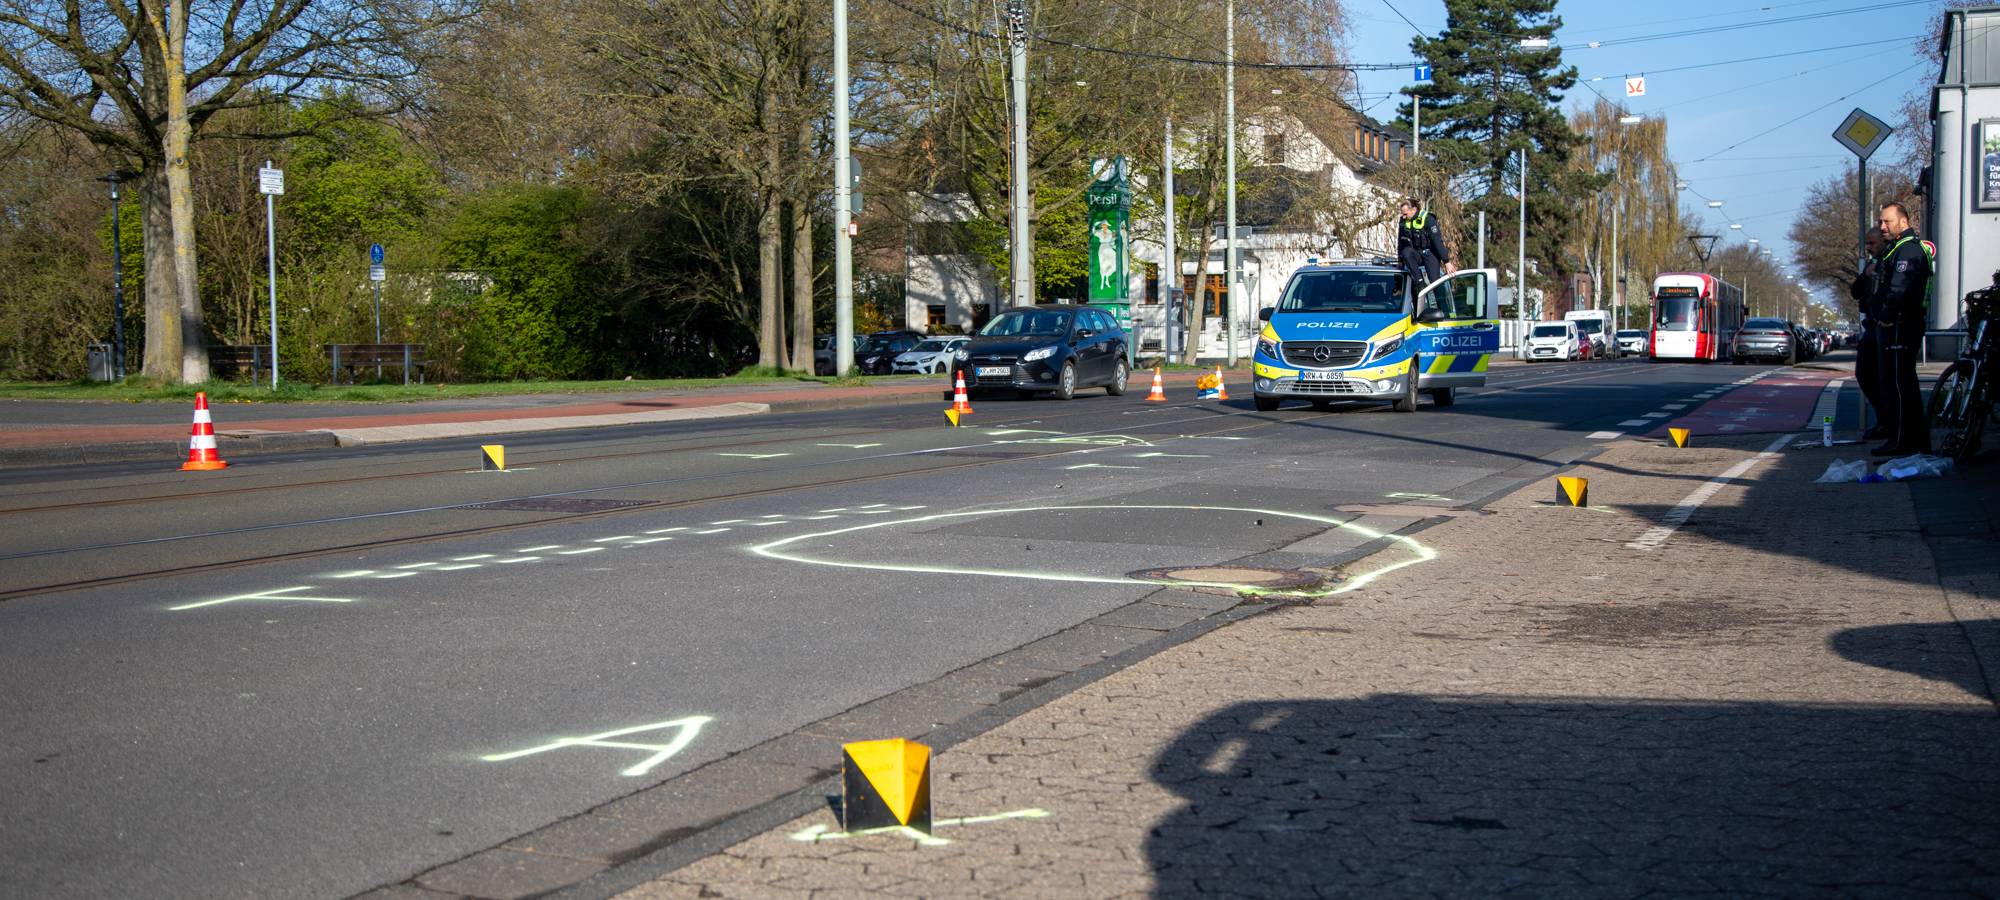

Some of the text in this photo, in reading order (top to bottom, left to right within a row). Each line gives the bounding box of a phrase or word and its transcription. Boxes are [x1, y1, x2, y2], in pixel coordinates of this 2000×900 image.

[1417, 66, 1428, 80] T
[1090, 193, 1117, 206] Persil
[1296, 321, 1360, 329] POLIZEI
[1432, 335, 1482, 348] POLIZEI
[1304, 372, 1316, 380] NRW
[1326, 372, 1343, 380] 6859
